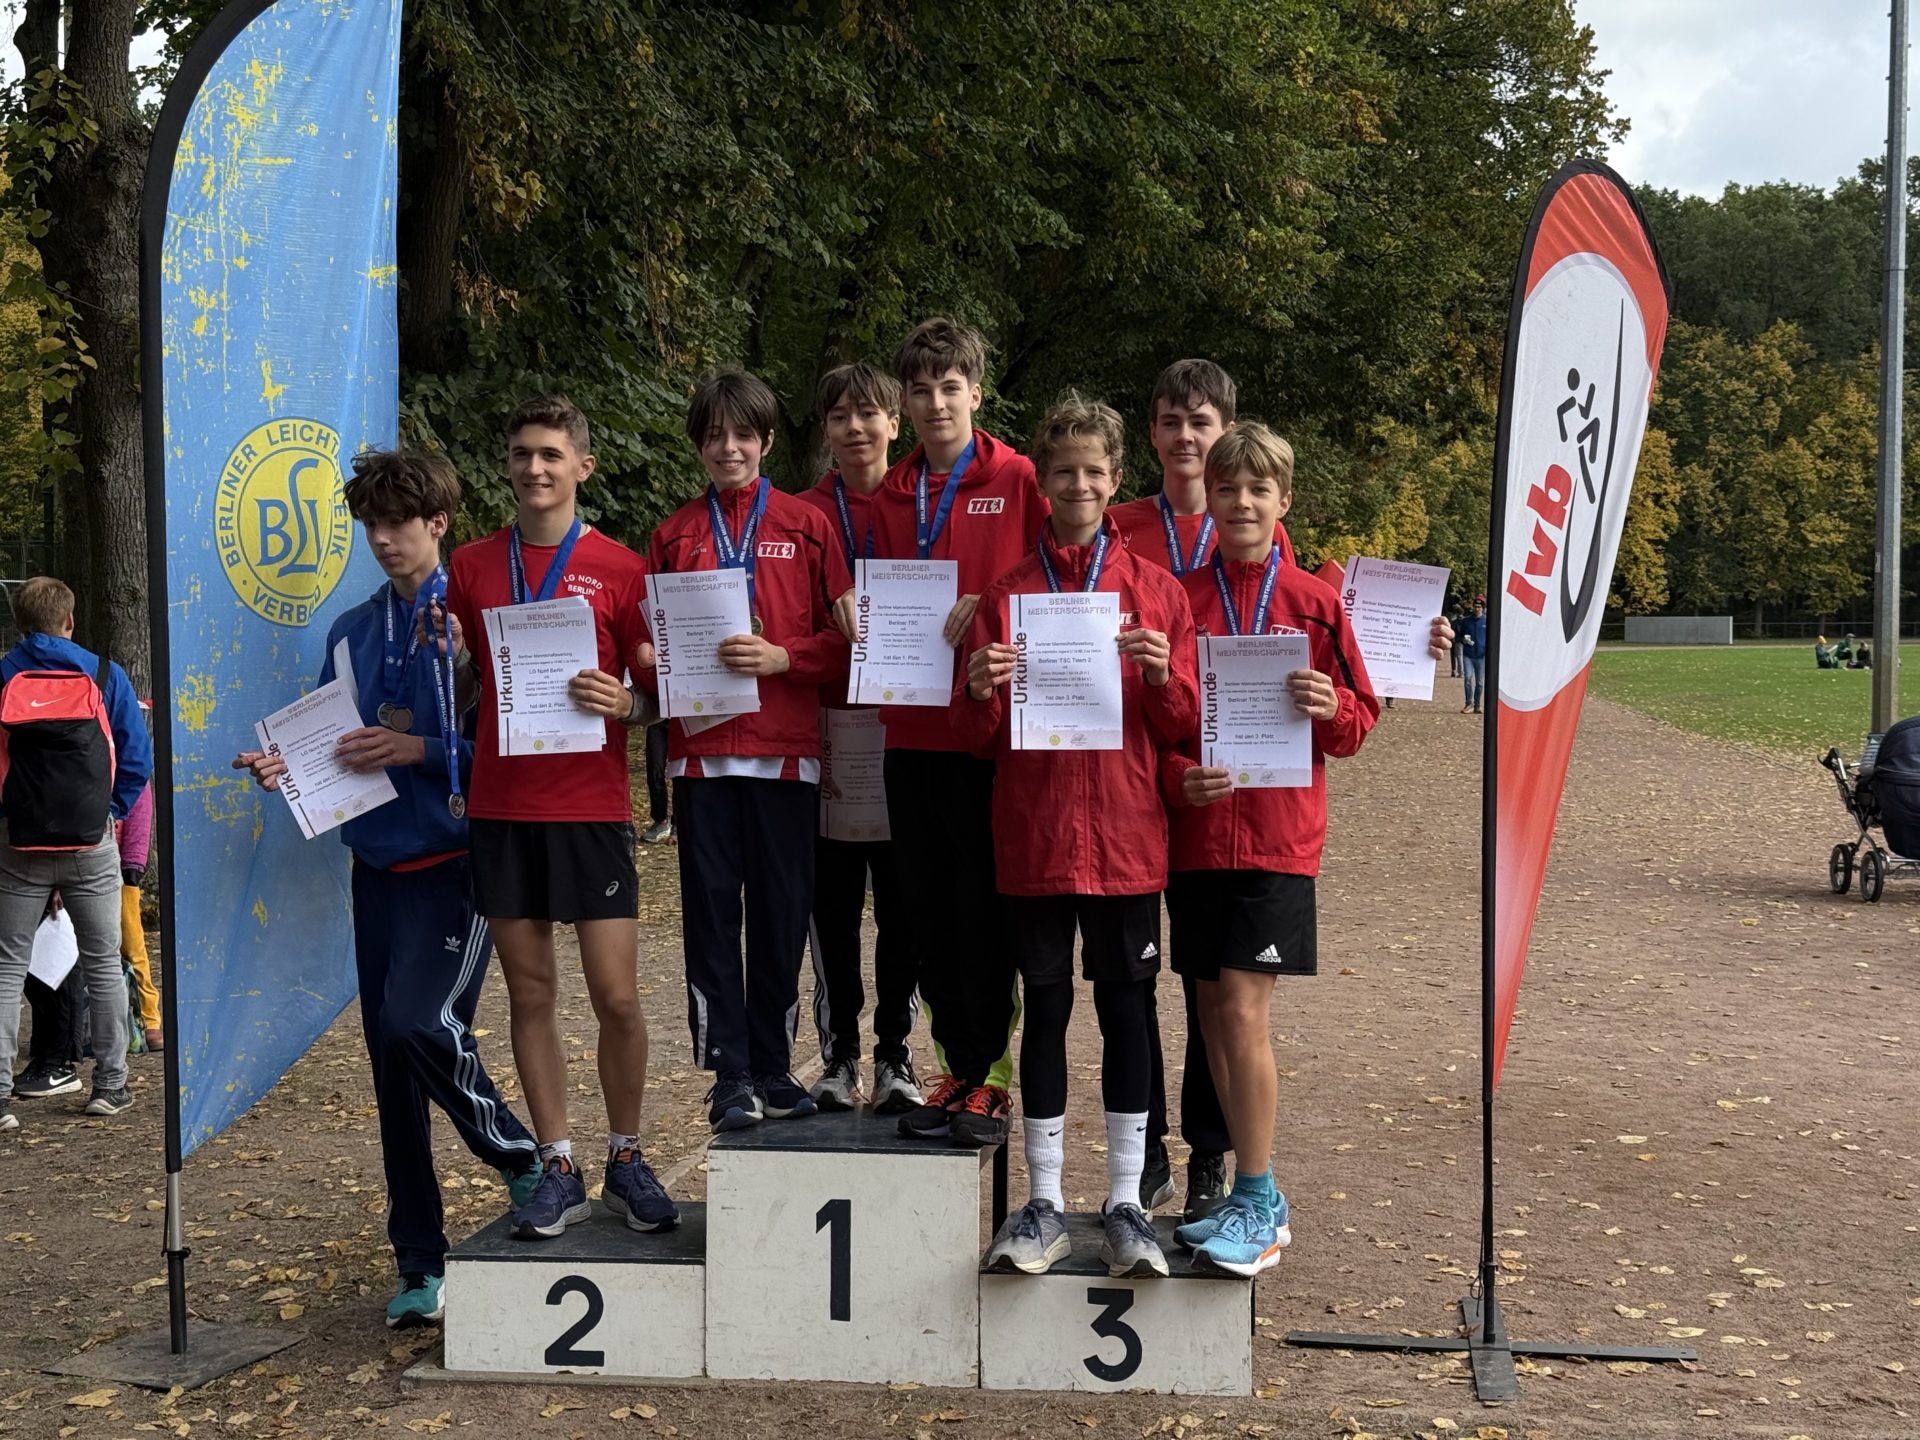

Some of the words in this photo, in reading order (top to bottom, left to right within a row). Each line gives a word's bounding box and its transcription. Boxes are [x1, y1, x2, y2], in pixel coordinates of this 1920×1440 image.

[219, 443, 258, 568] BERLINER
[891, 564, 930, 572] BERLINER
[1384, 564, 1422, 575] BERLINER
[563, 573, 576, 583] LG
[577, 574, 603, 590] NORD
[680, 575, 718, 583] BERLINER
[1362, 569, 1439, 585] MEISTERSCHAFTEN
[567, 584, 596, 596] BERLIN
[663, 582, 739, 593] MEISTERSCHAFTEN
[527, 613, 566, 621] BERLINER
[1028, 607, 1111, 615] MEISTERSCHAFTEN
[508, 620, 587, 631] MEISTERSCHAFTEN
[854, 595, 870, 662] Urkunde
[653, 608, 671, 675] Urkunde
[1216, 649, 1300, 657] MEISTERSCHAFTEN
[1014, 632, 1027, 704] Urkunde
[498, 645, 513, 714] Urkunde
[1204, 672, 1218, 742] Urkunde
[1255, 954, 1282, 964] adidas
[815, 1199, 852, 1322] 1
[543, 1275, 605, 1367] 2
[1083, 1287, 1143, 1383] 3
